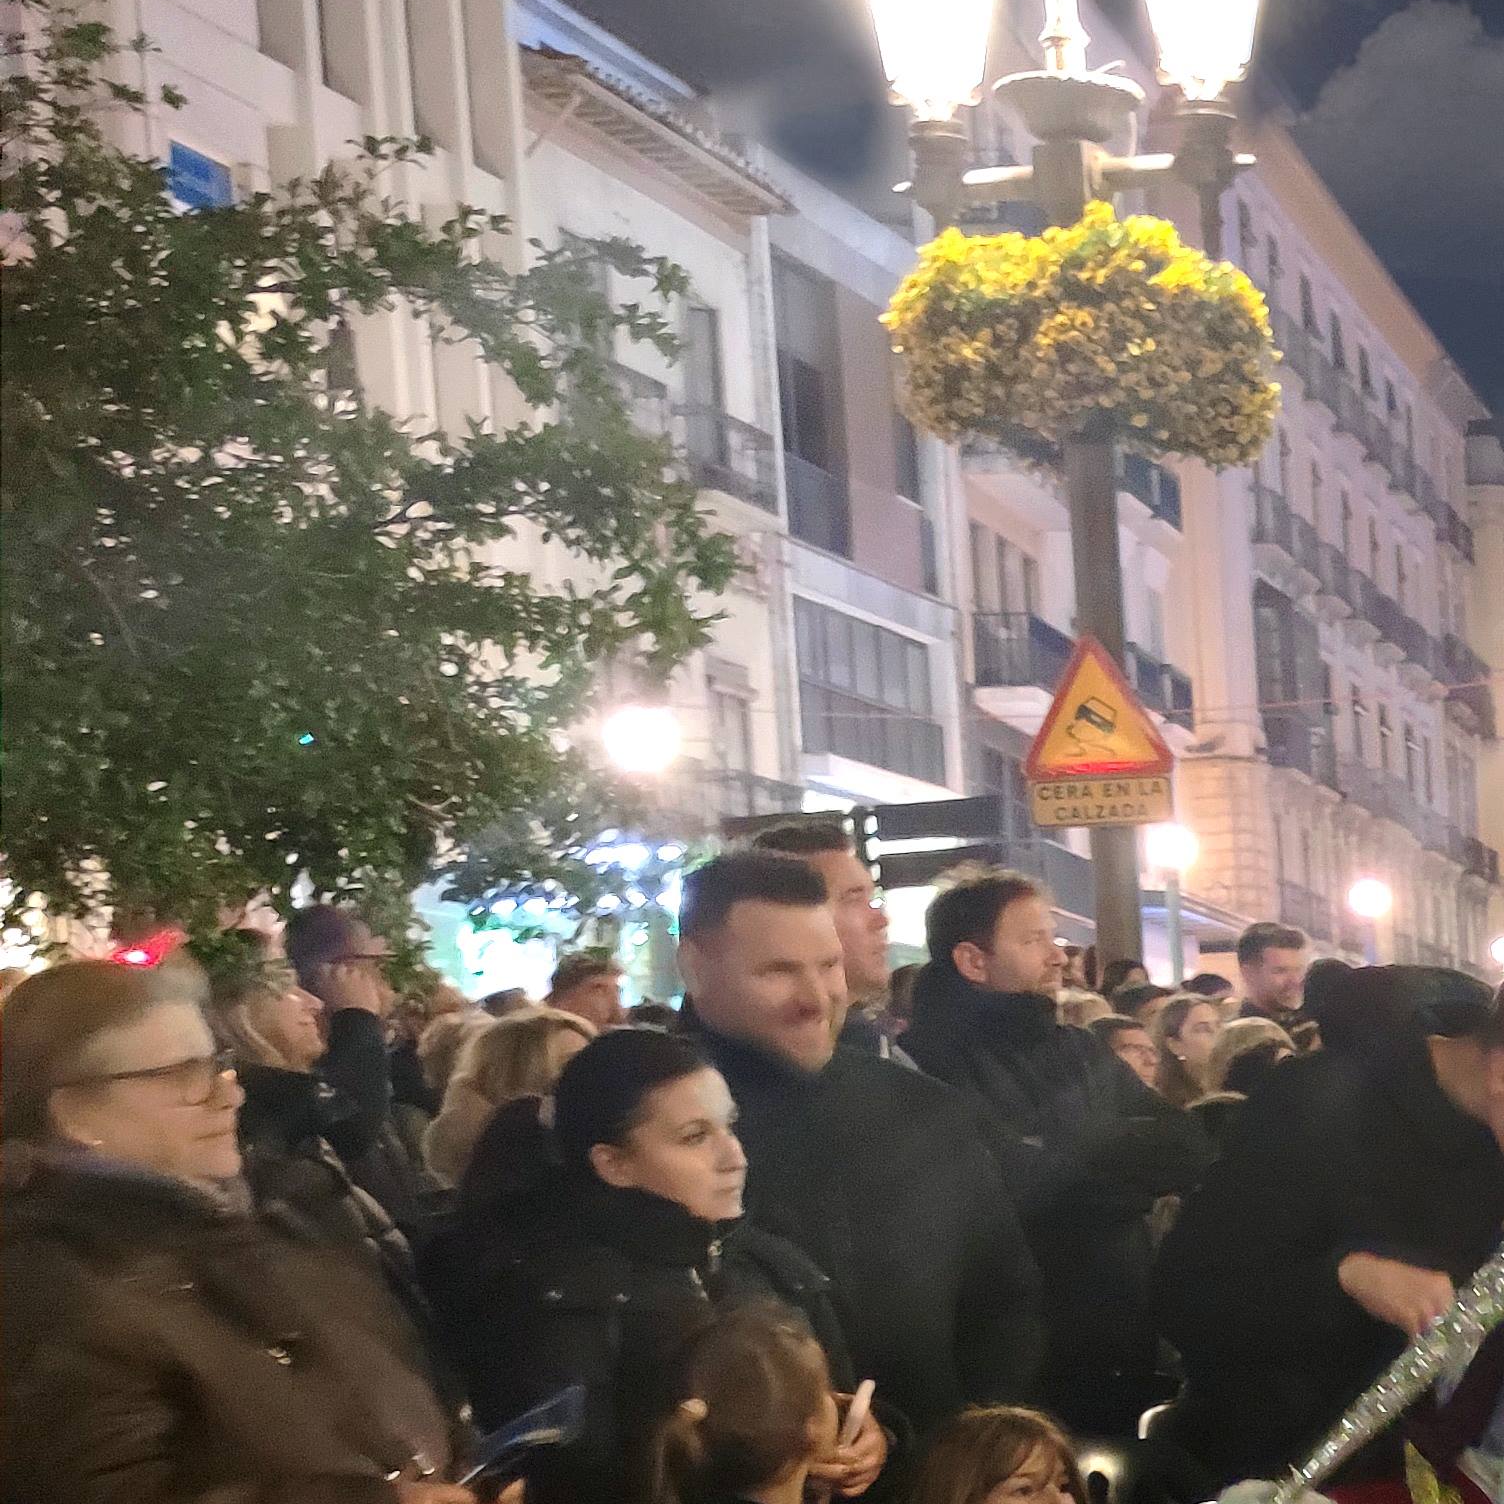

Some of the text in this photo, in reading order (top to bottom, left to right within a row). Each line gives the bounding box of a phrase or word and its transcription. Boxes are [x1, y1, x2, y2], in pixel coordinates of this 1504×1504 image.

[1038, 780, 1163, 800] CERA EN LA
[1055, 803, 1148, 820] CALZADA
